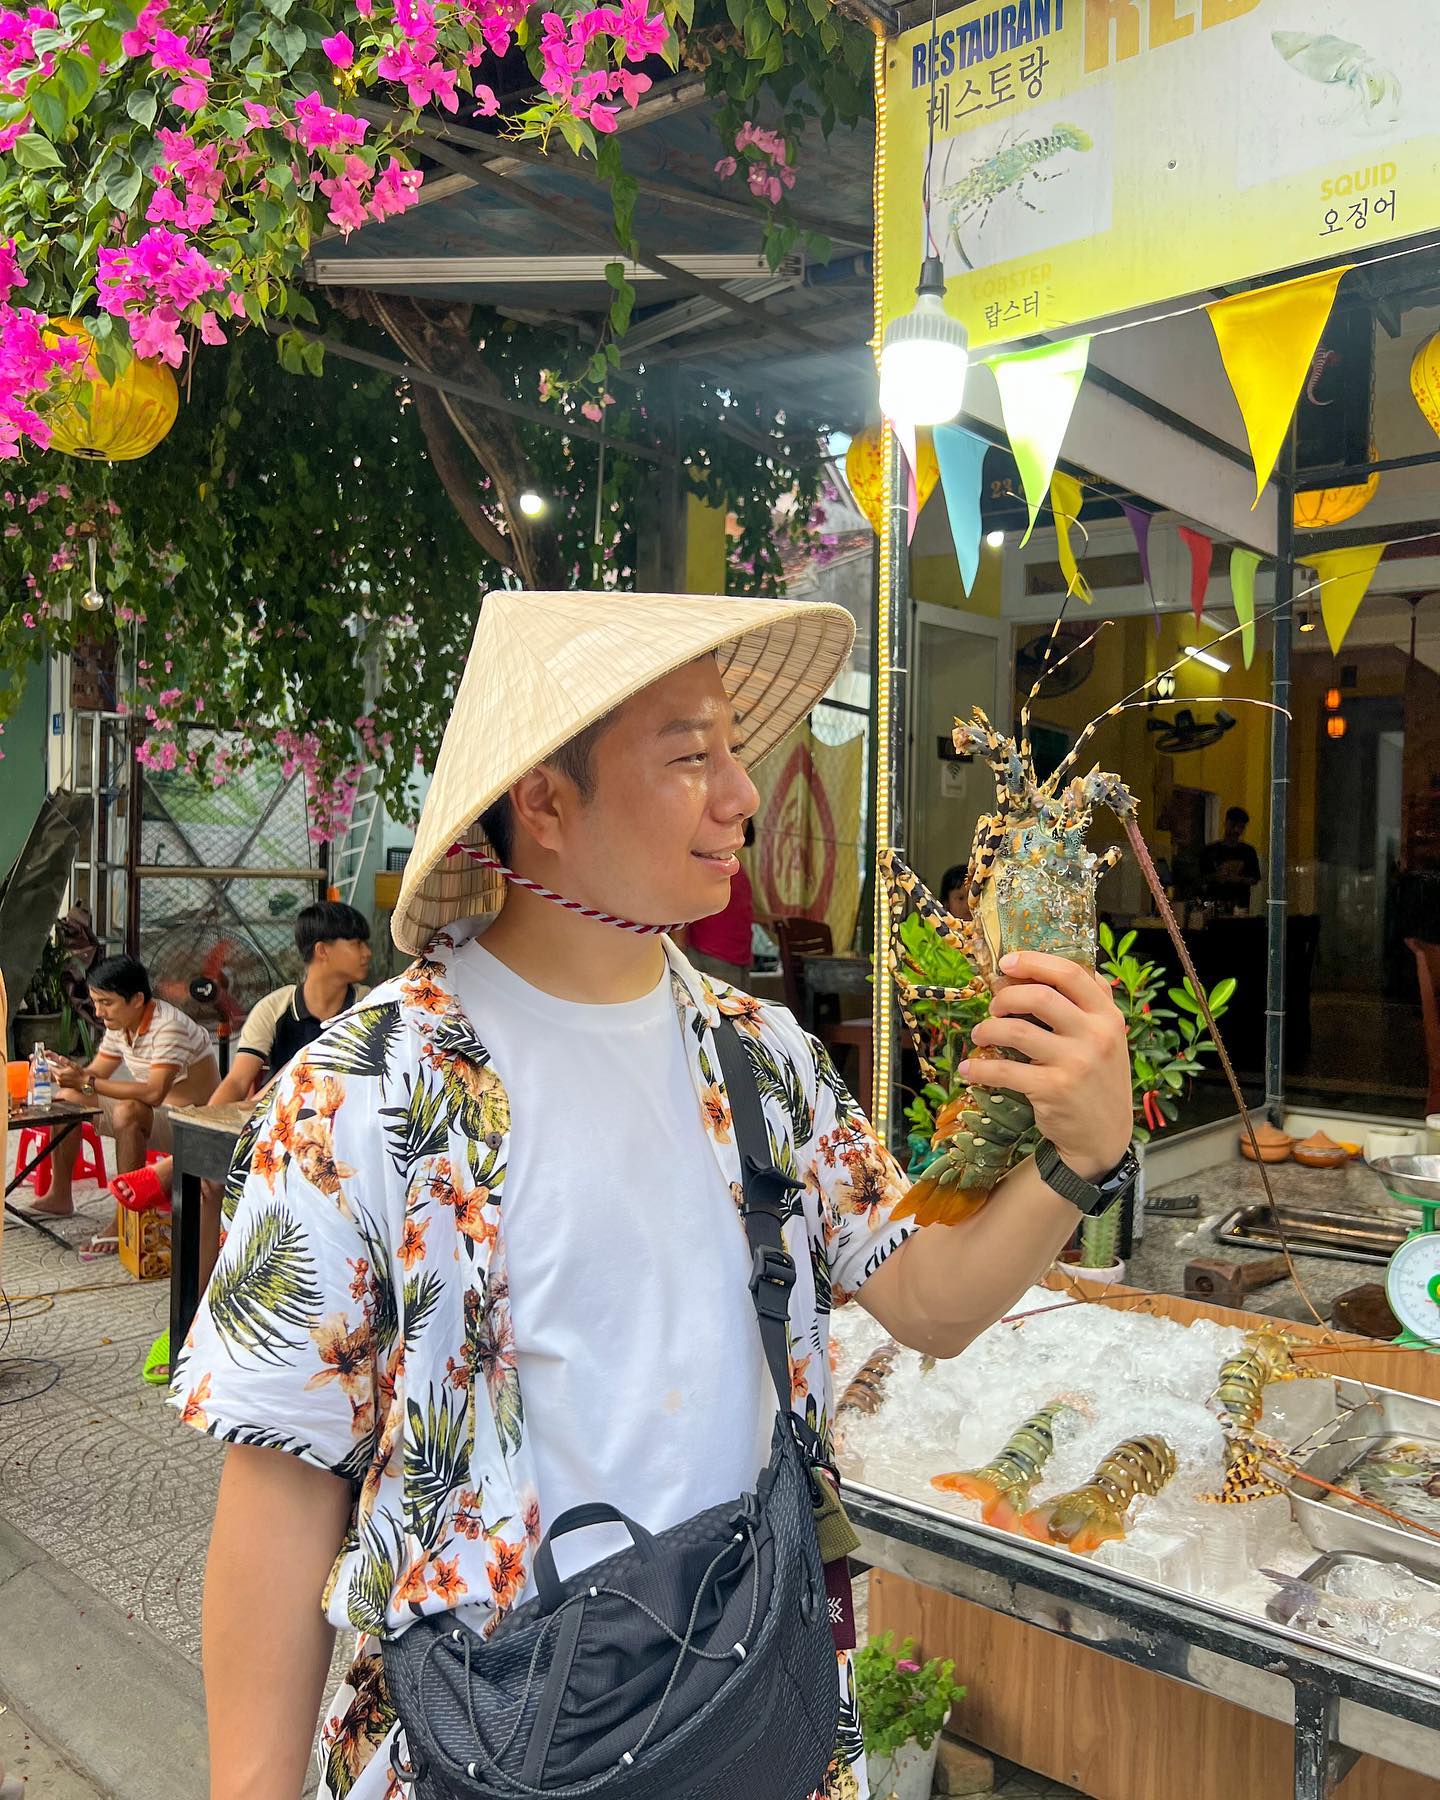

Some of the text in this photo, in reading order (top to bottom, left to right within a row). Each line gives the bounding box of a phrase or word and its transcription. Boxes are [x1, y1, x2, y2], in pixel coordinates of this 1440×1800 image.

[912, 0, 1064, 90] RESTAURANT
[1319, 161, 1397, 202] SQUID
[1318, 189, 1396, 236] 오징어
[984, 290, 1039, 330] 랍스터
